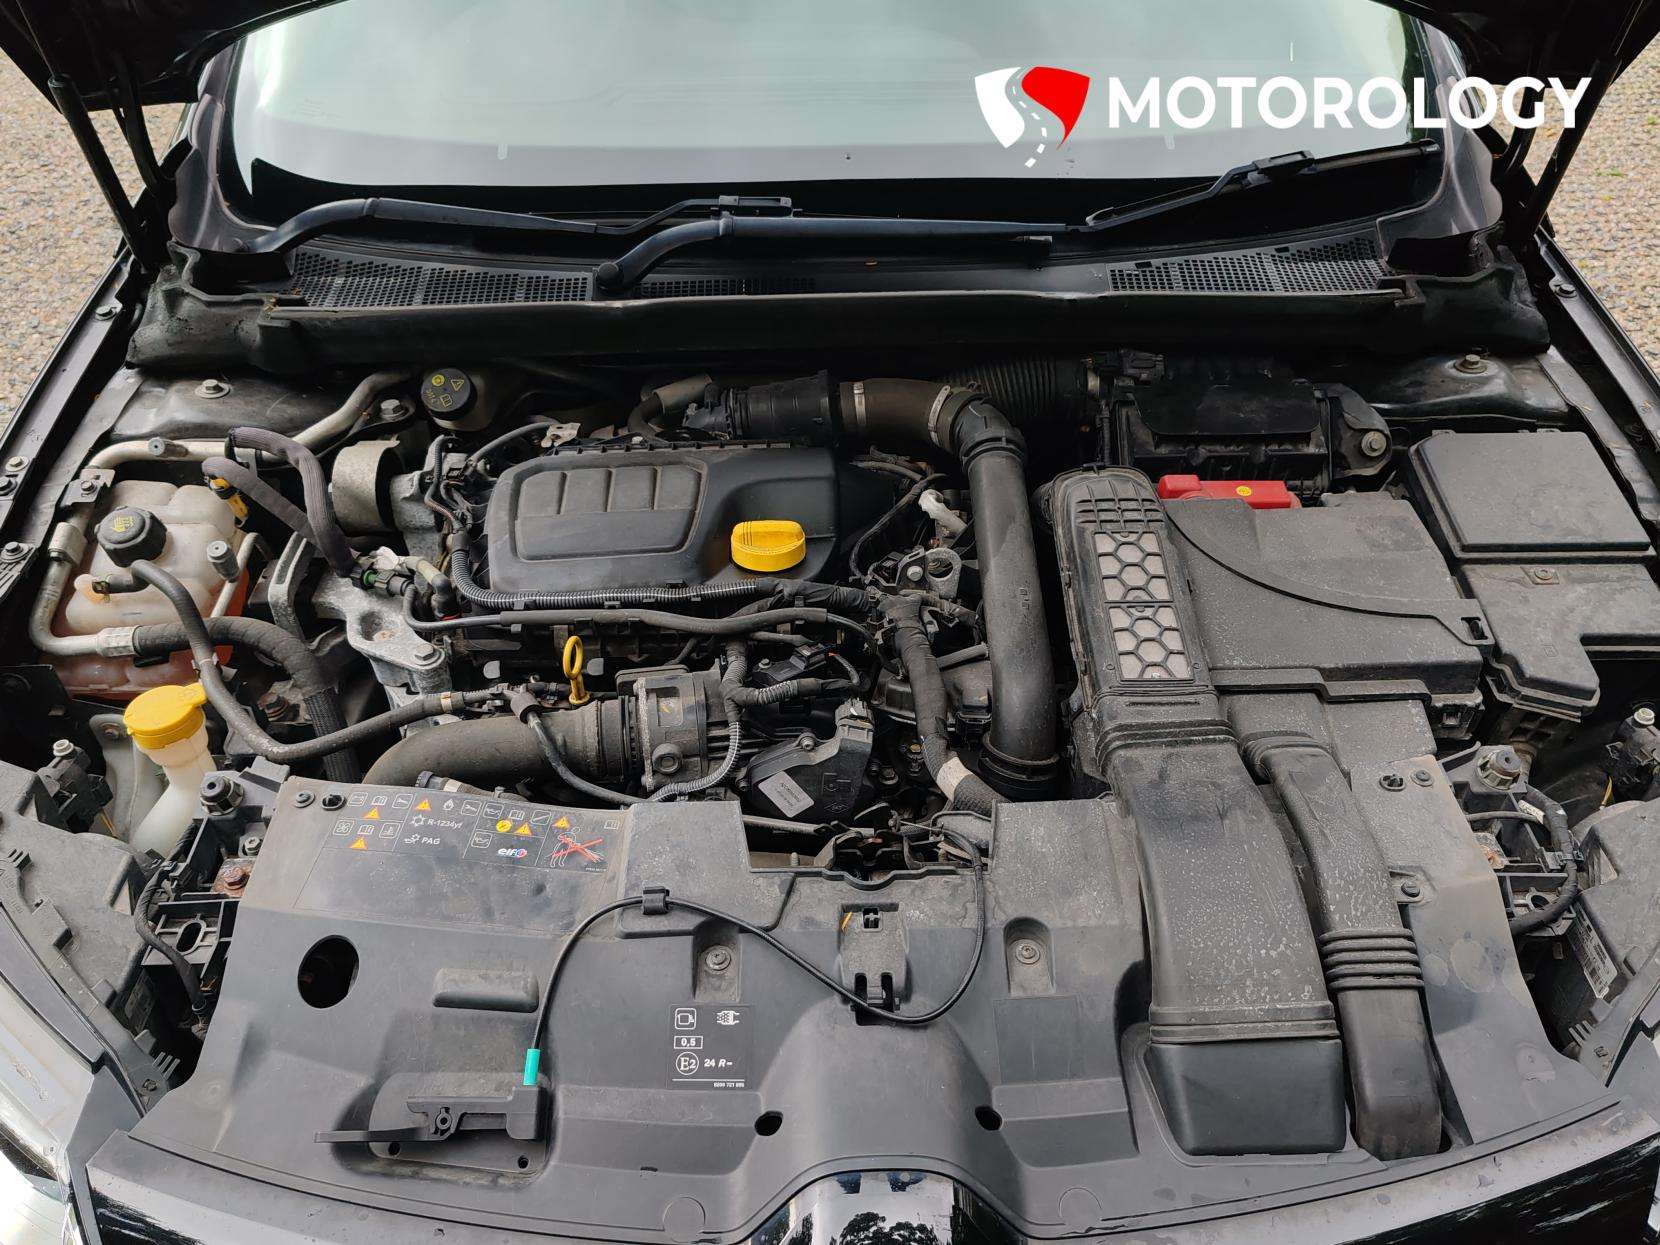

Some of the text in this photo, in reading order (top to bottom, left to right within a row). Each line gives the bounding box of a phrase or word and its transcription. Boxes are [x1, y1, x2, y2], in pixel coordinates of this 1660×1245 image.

[421, 836, 441, 845] PAG
[680, 1057, 696, 1070] E2
[704, 1058, 716, 1068] 24
